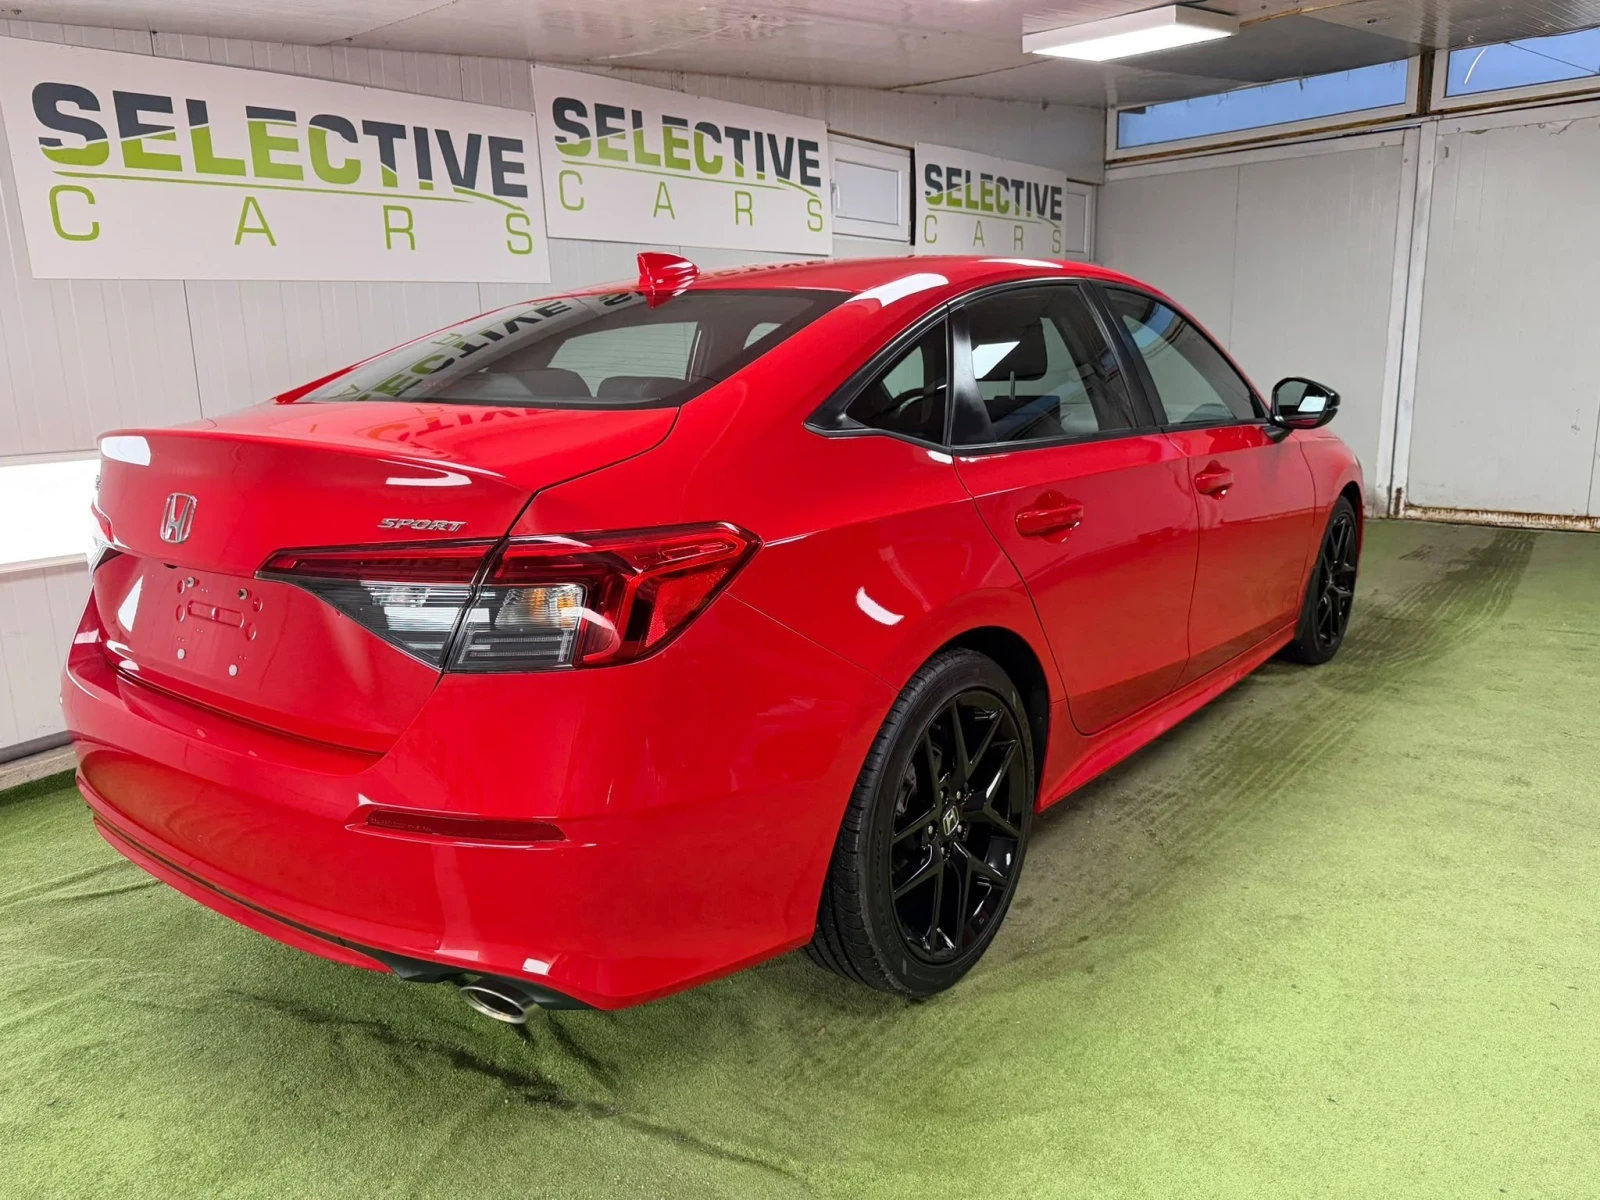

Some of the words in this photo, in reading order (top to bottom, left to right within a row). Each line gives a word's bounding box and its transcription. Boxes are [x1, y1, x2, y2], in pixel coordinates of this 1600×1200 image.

[32, 82, 529, 198] SELECTIVE
[552, 96, 822, 188] SELECTIVE
[49, 184, 533, 255] CARS
[558, 170, 823, 232] CARS
[924, 163, 1062, 221] SELECTIVE
[924, 215, 1062, 254] CARS
[377, 517, 467, 532] SPORT
